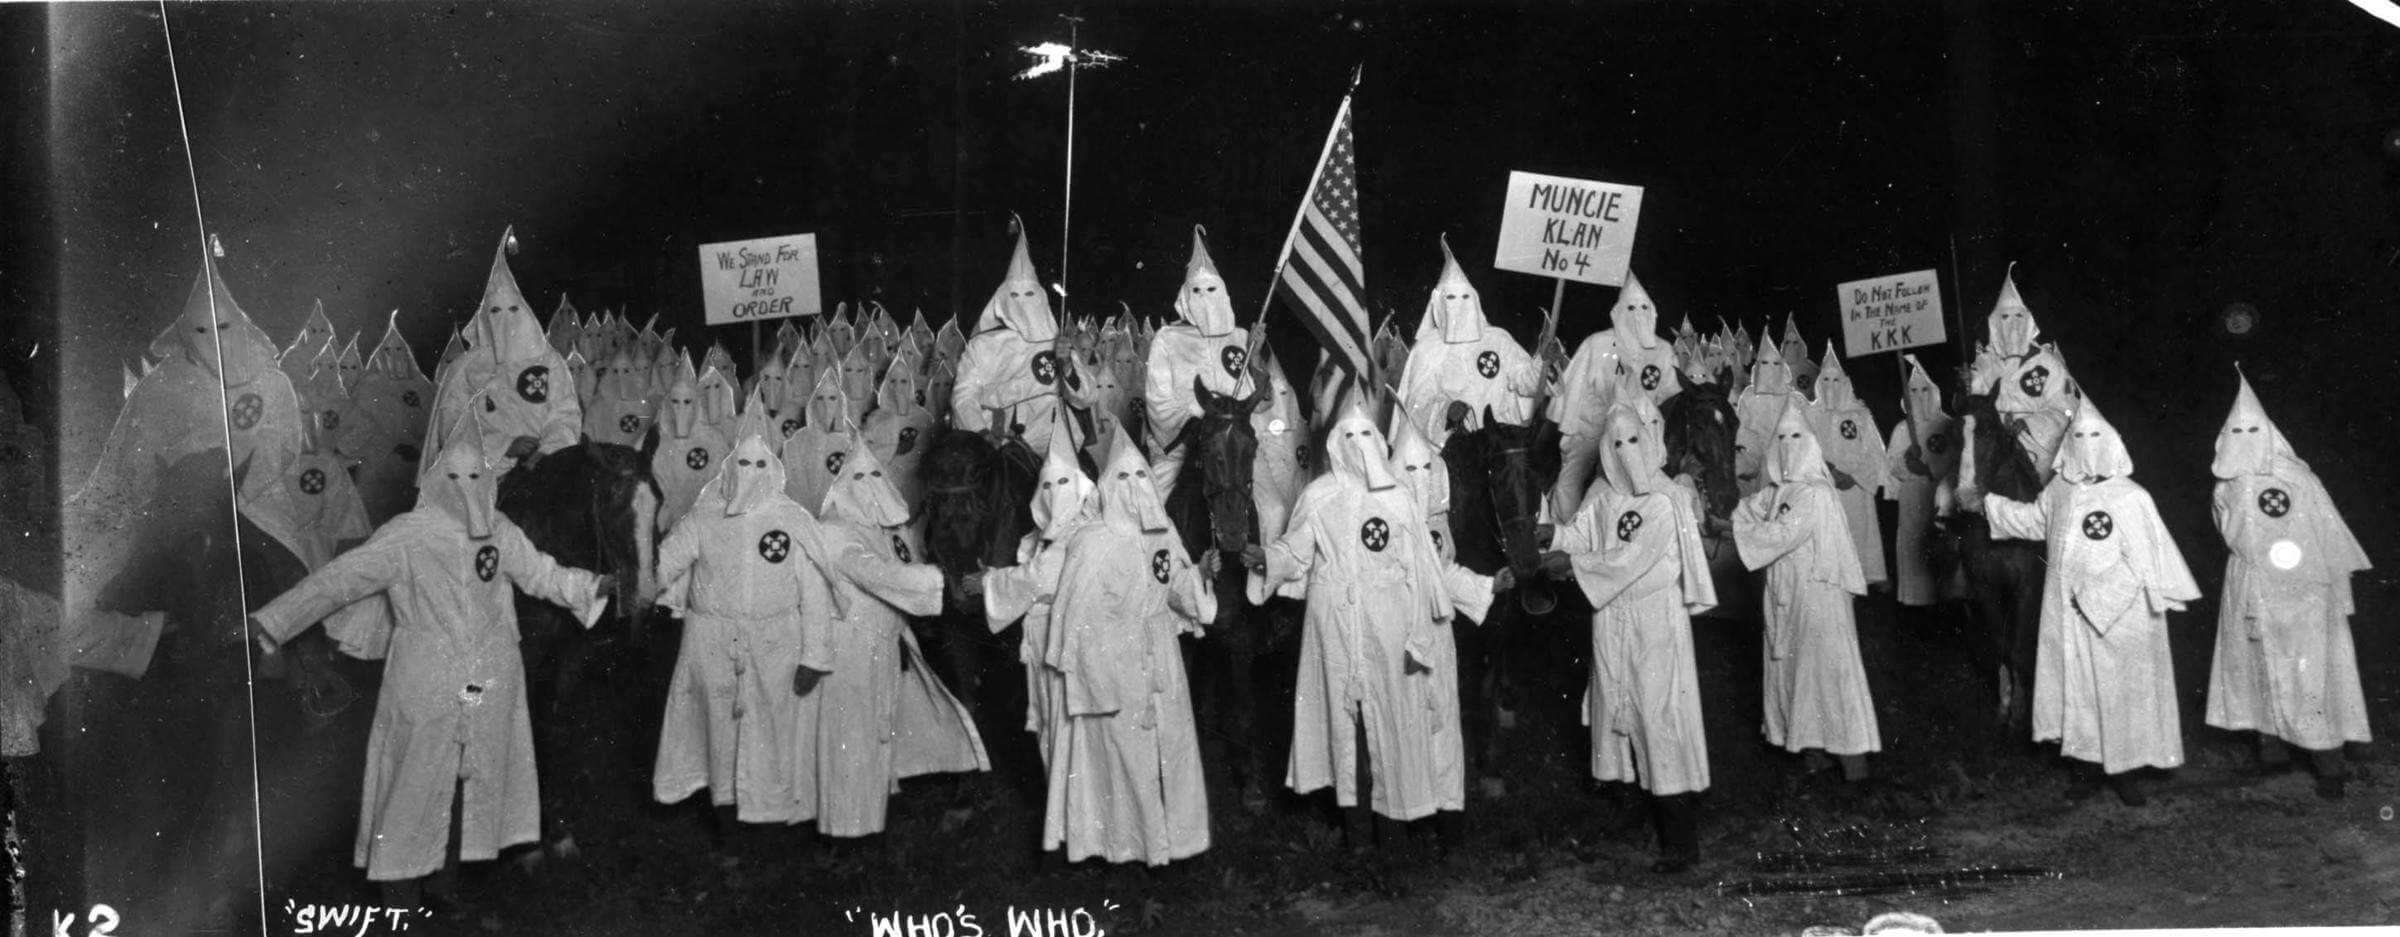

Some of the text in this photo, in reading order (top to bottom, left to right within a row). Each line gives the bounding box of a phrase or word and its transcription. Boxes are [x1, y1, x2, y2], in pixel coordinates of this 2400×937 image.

[1529, 183, 1621, 222] MUNCIE
[1542, 217, 1603, 249] KLAN
[739, 247, 771, 269] STAND
[776, 244, 799, 263] FOR
[1542, 248, 1590, 275] No 4
[739, 268, 779, 288] LAW
[733, 296, 794, 317] ORDER
